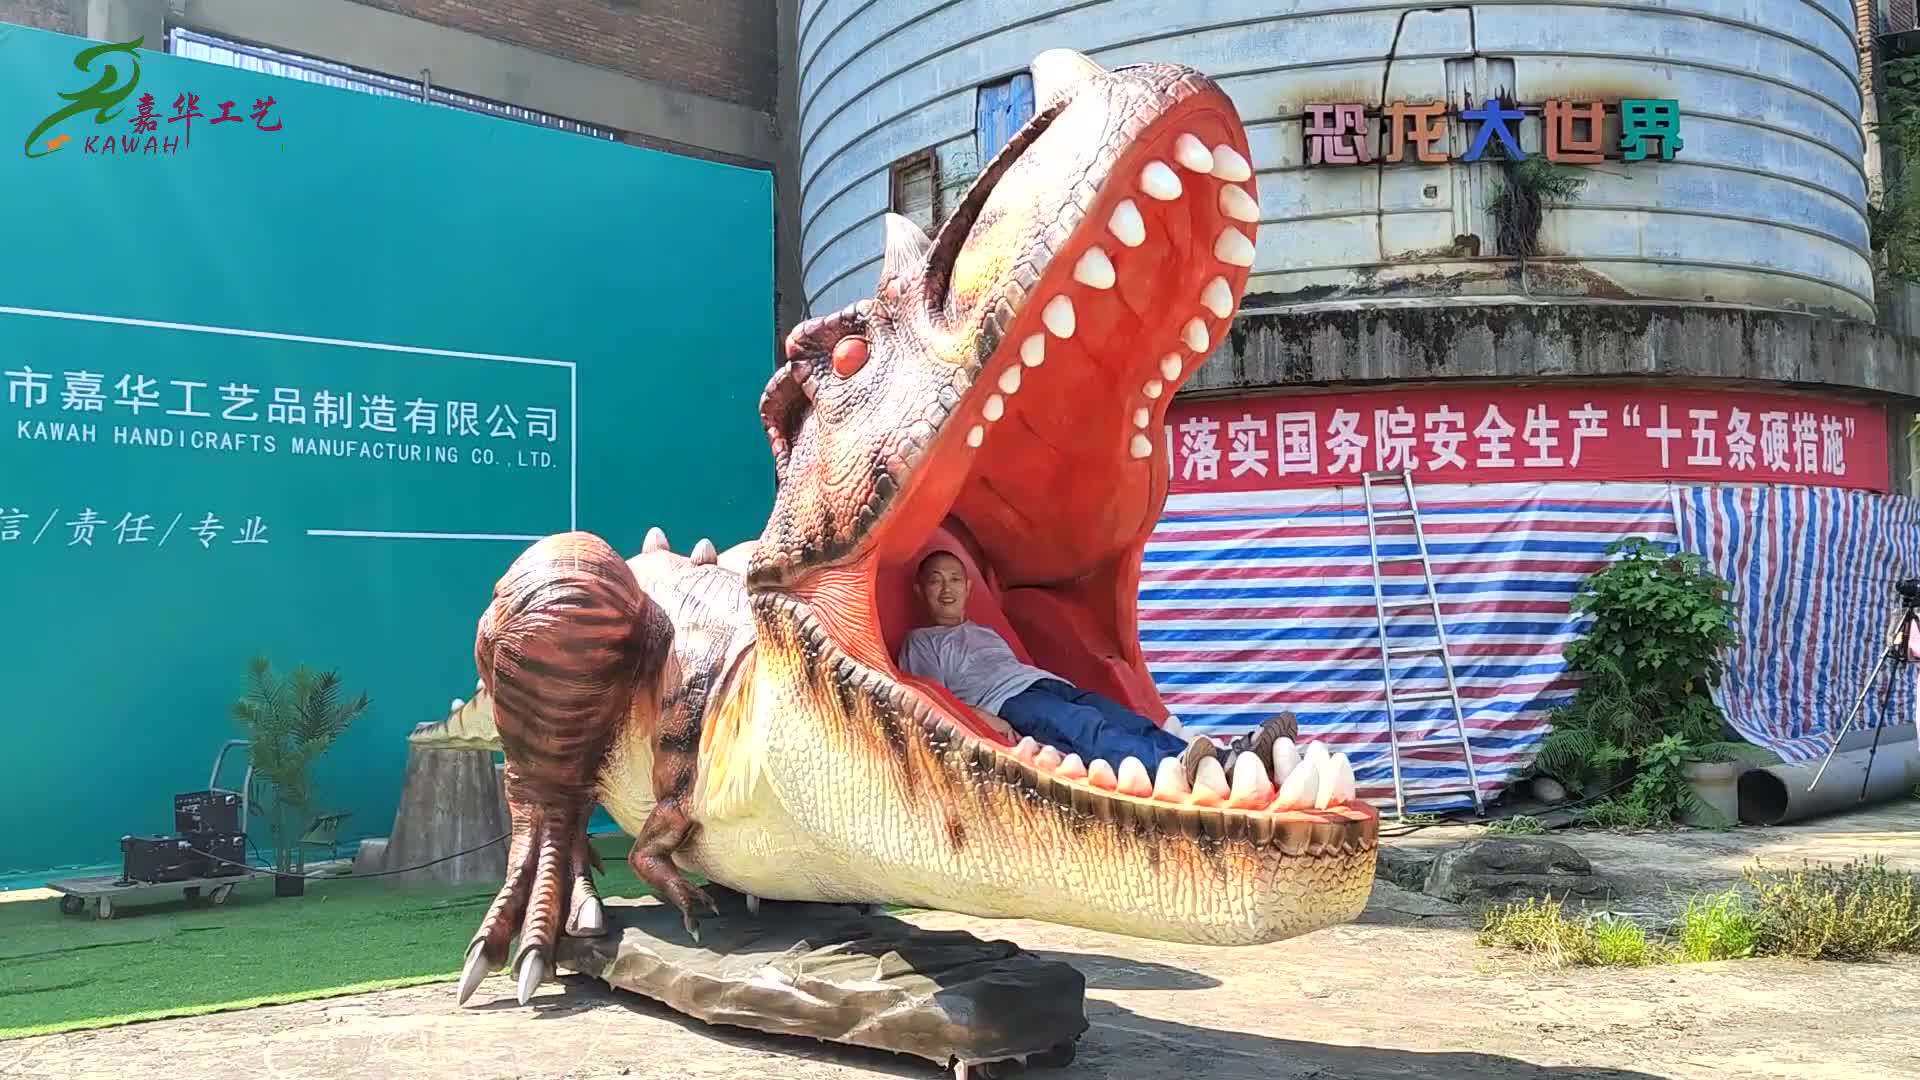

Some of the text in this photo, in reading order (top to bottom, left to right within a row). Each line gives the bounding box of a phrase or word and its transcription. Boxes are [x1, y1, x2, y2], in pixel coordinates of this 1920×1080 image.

[1303, 99, 1684, 165] 恐龙大世界
[3, 364, 559, 443] 市嘉华工艺品制造有限公司
[17, 419, 97, 443] KAWAH
[113, 425, 277, 454] HANDICRAFTS
[291, 436, 459, 464] MANUFACTURING
[1165, 403, 1855, 480] 落实国务院安全生产“十五条硬措施”
